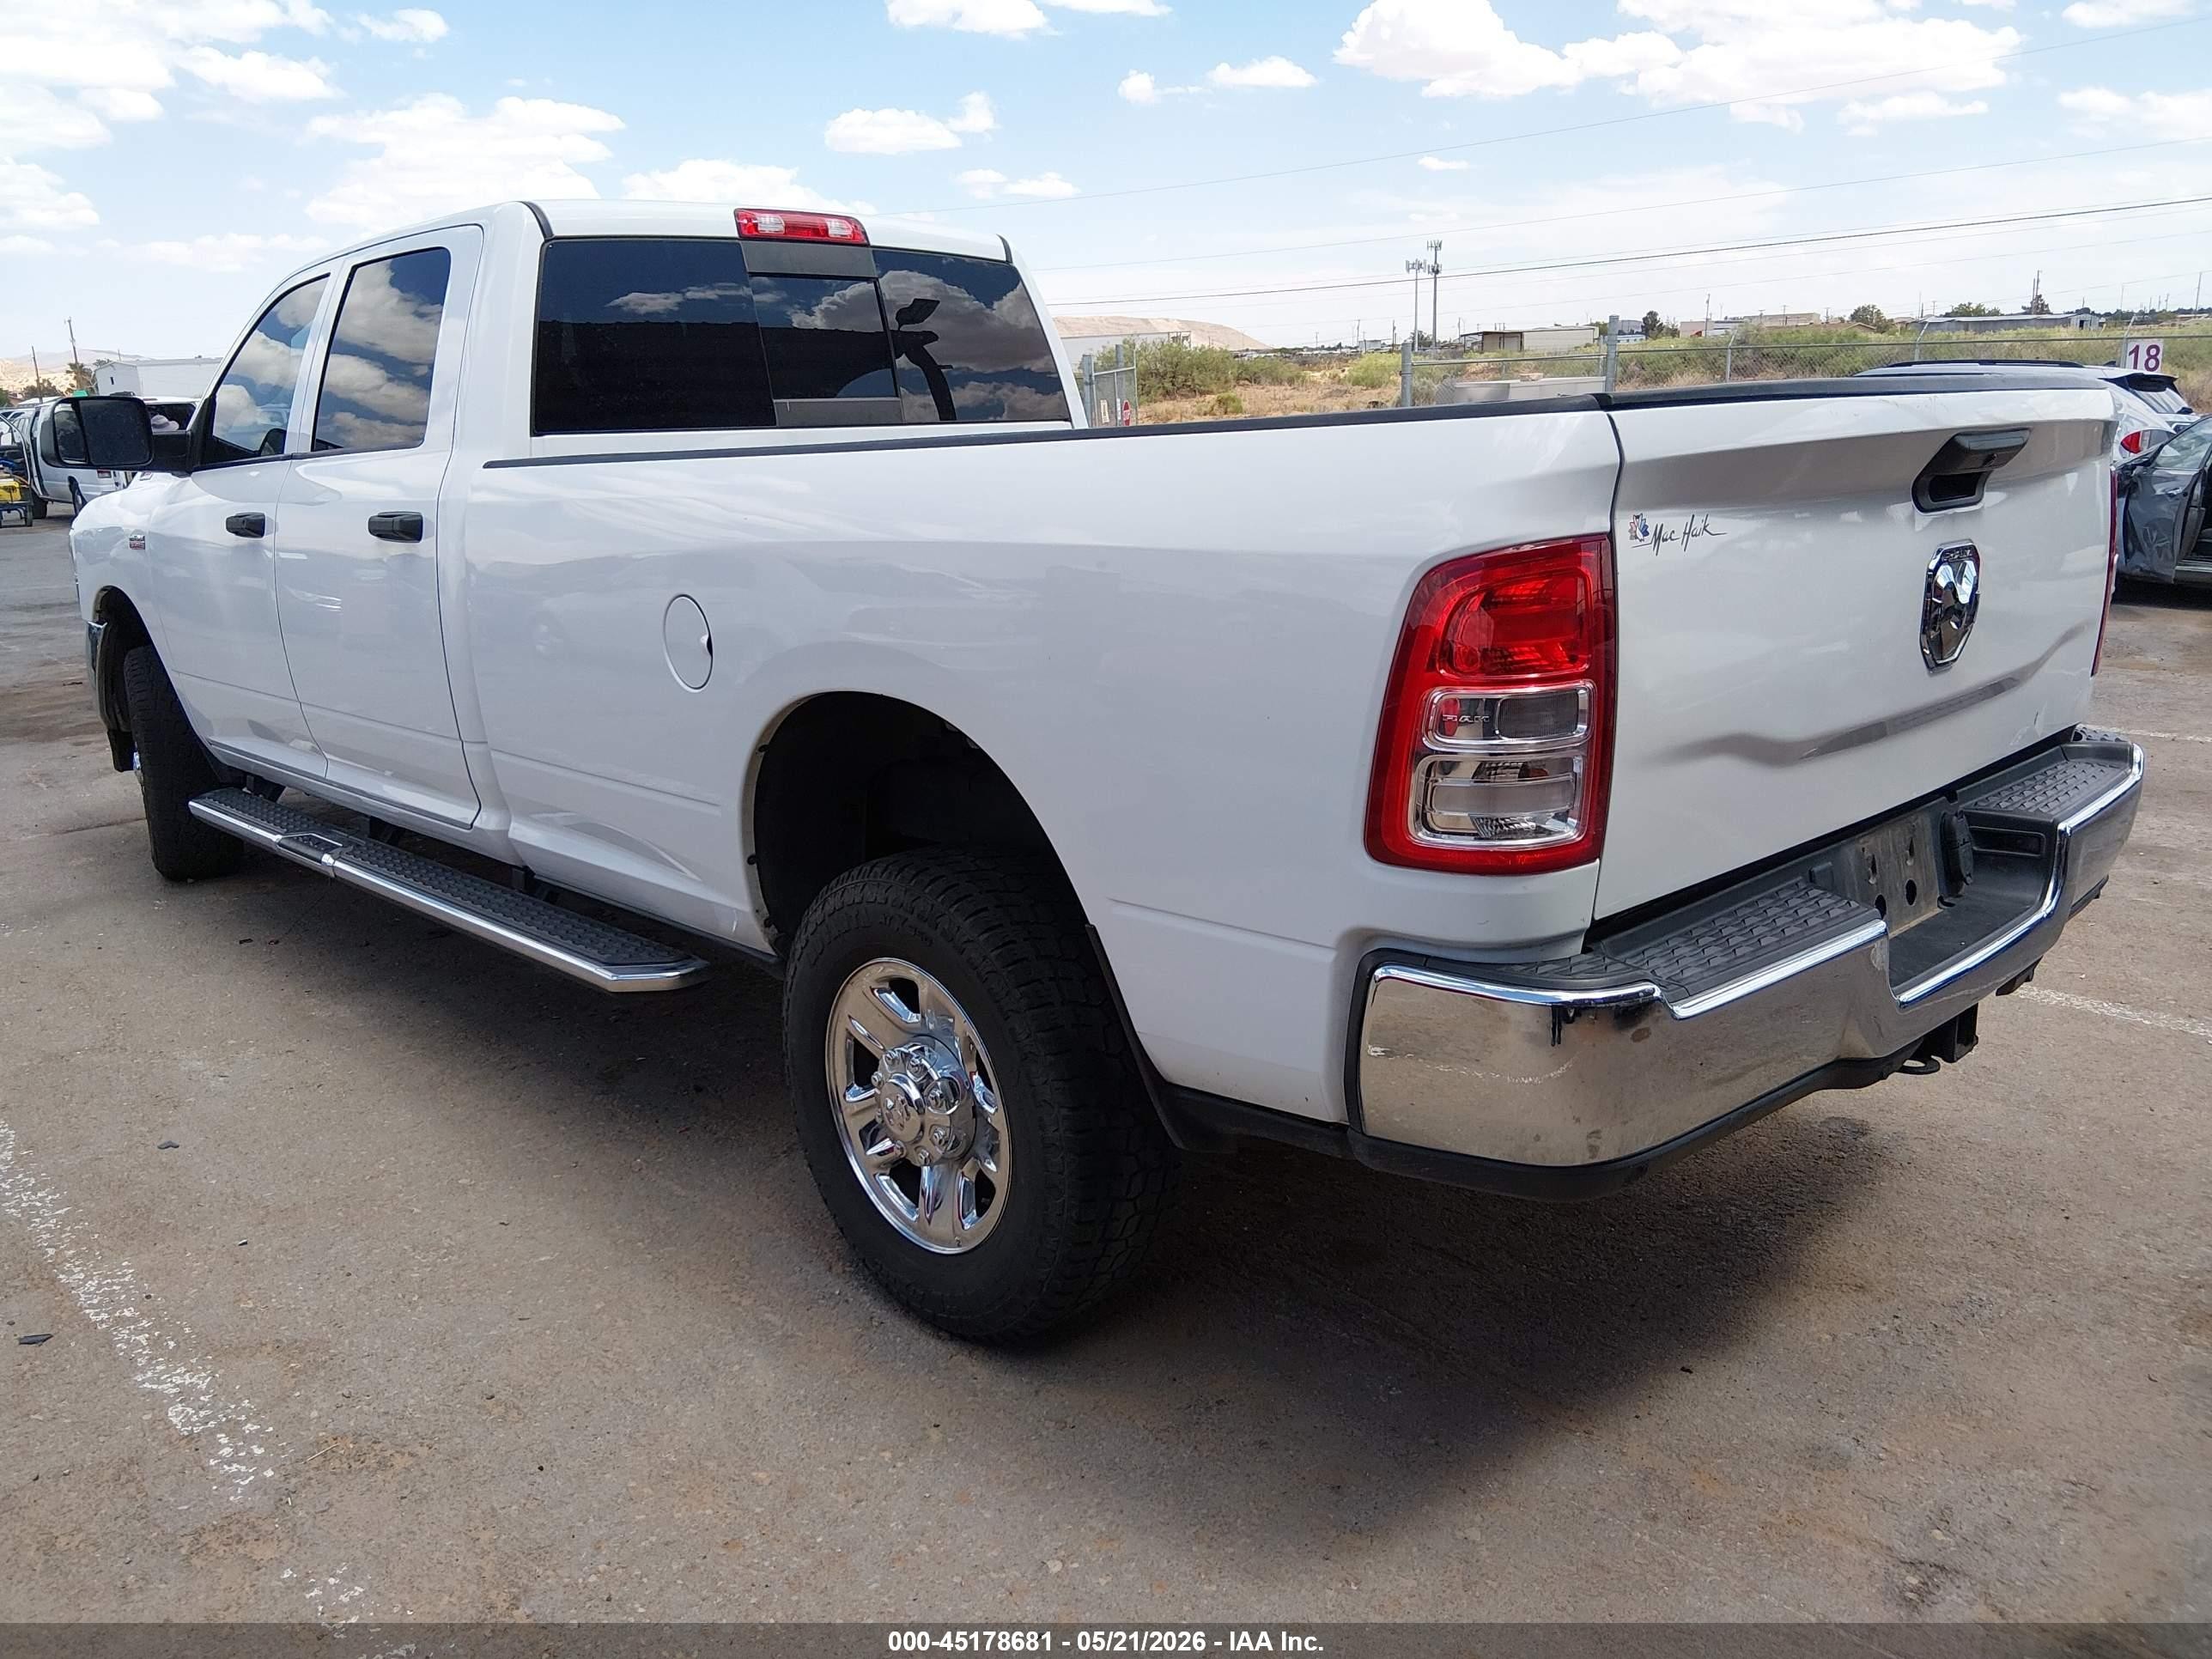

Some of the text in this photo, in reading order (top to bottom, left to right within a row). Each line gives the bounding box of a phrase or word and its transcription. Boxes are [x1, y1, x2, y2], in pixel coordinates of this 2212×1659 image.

[2128, 344, 2161, 373] 18
[1632, 514, 1728, 556] Mac Haik
